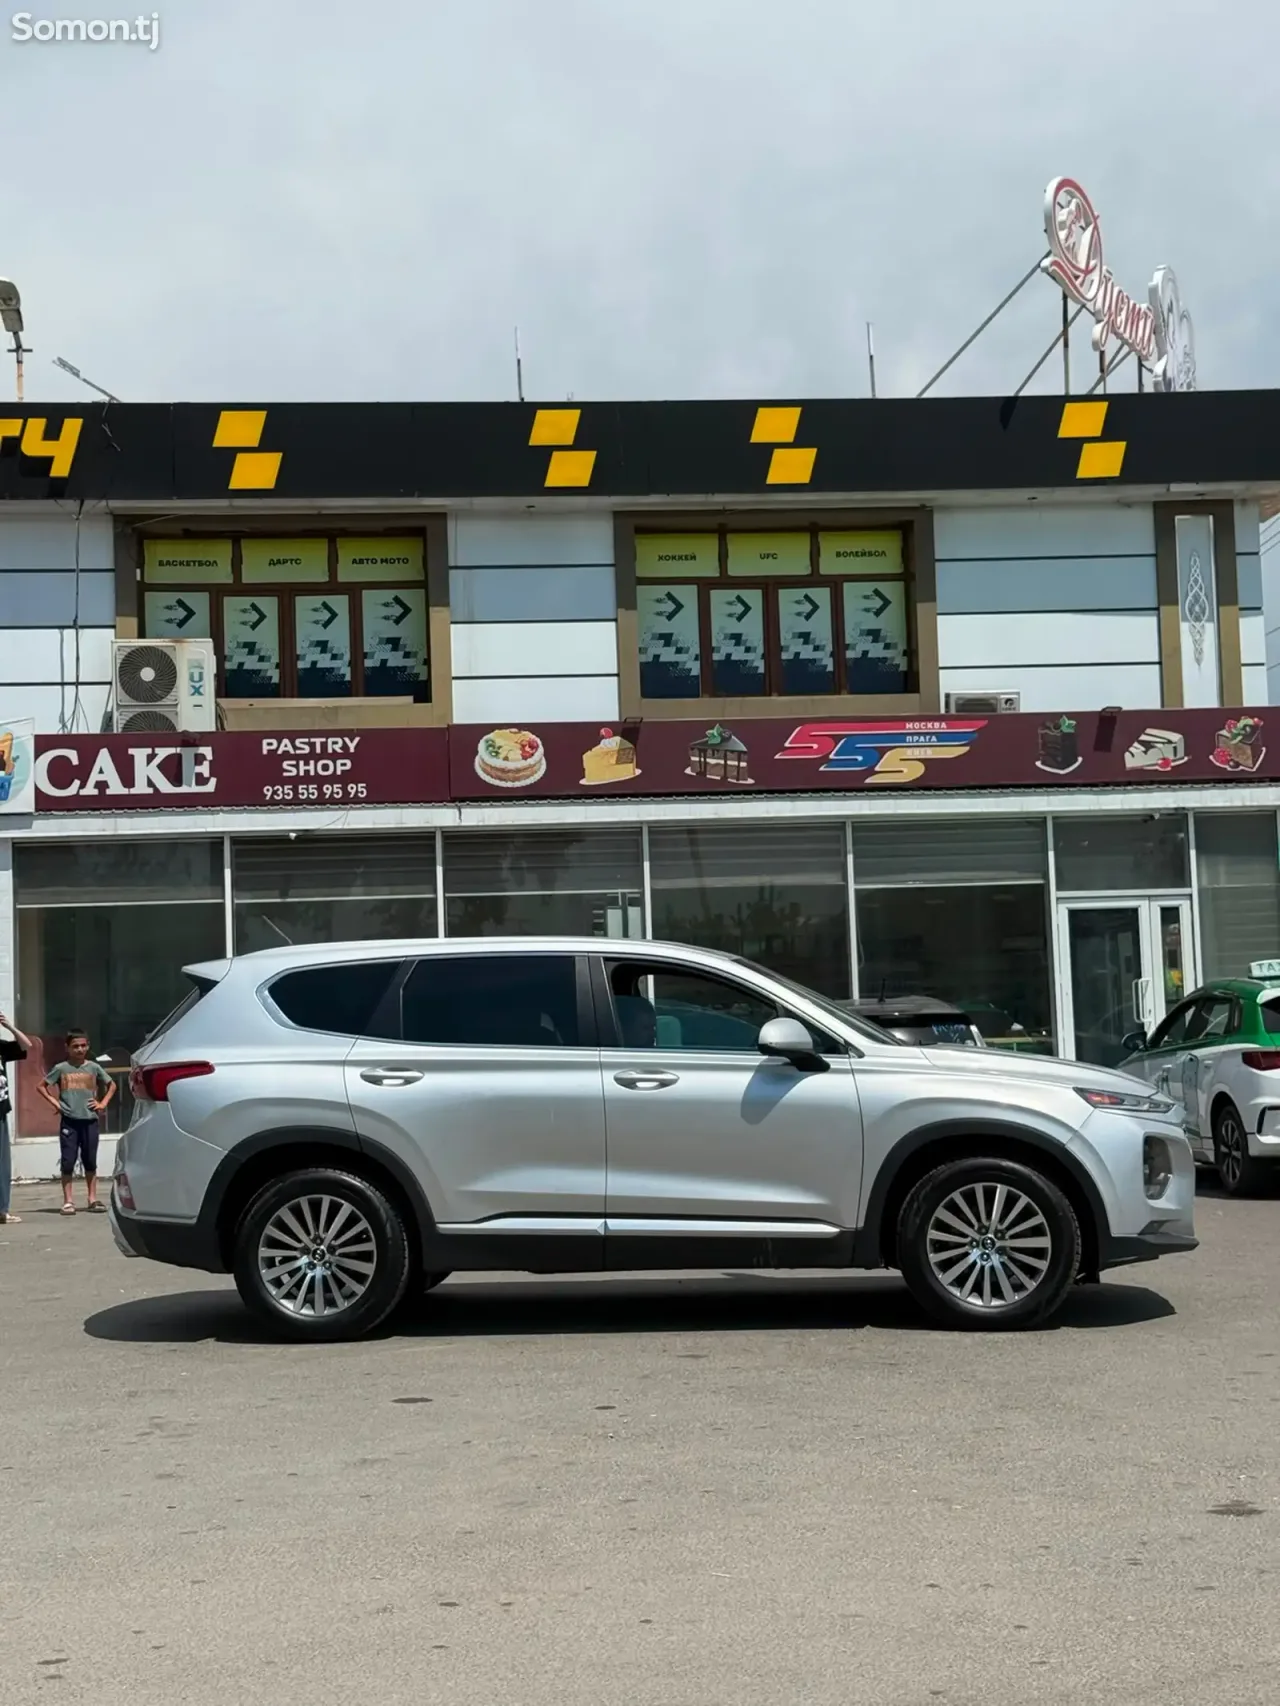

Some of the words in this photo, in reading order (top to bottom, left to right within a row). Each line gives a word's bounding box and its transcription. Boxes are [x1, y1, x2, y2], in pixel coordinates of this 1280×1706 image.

[657, 551, 697, 561] ХОККЕЙ
[759, 552, 778, 560] UFC
[835, 548, 887, 558] ВОЛЕЙБОЛ
[158, 559, 219, 568] БАСКЕТБОЛ
[268, 557, 302, 567] ДАРТС
[352, 557, 378, 565] АВТО
[380, 556, 409, 565] МОТО
[905, 721, 947, 729] МОСКВА
[905, 735, 937, 743] ПРАГА
[262, 736, 361, 755] PASTRY
[34, 746, 217, 797] CAKE
[282, 759, 352, 777] SHOP
[263, 785, 293, 800] 935
[298, 784, 318, 799] 55
[323, 783, 343, 799] 95
[347, 783, 367, 798] 95
